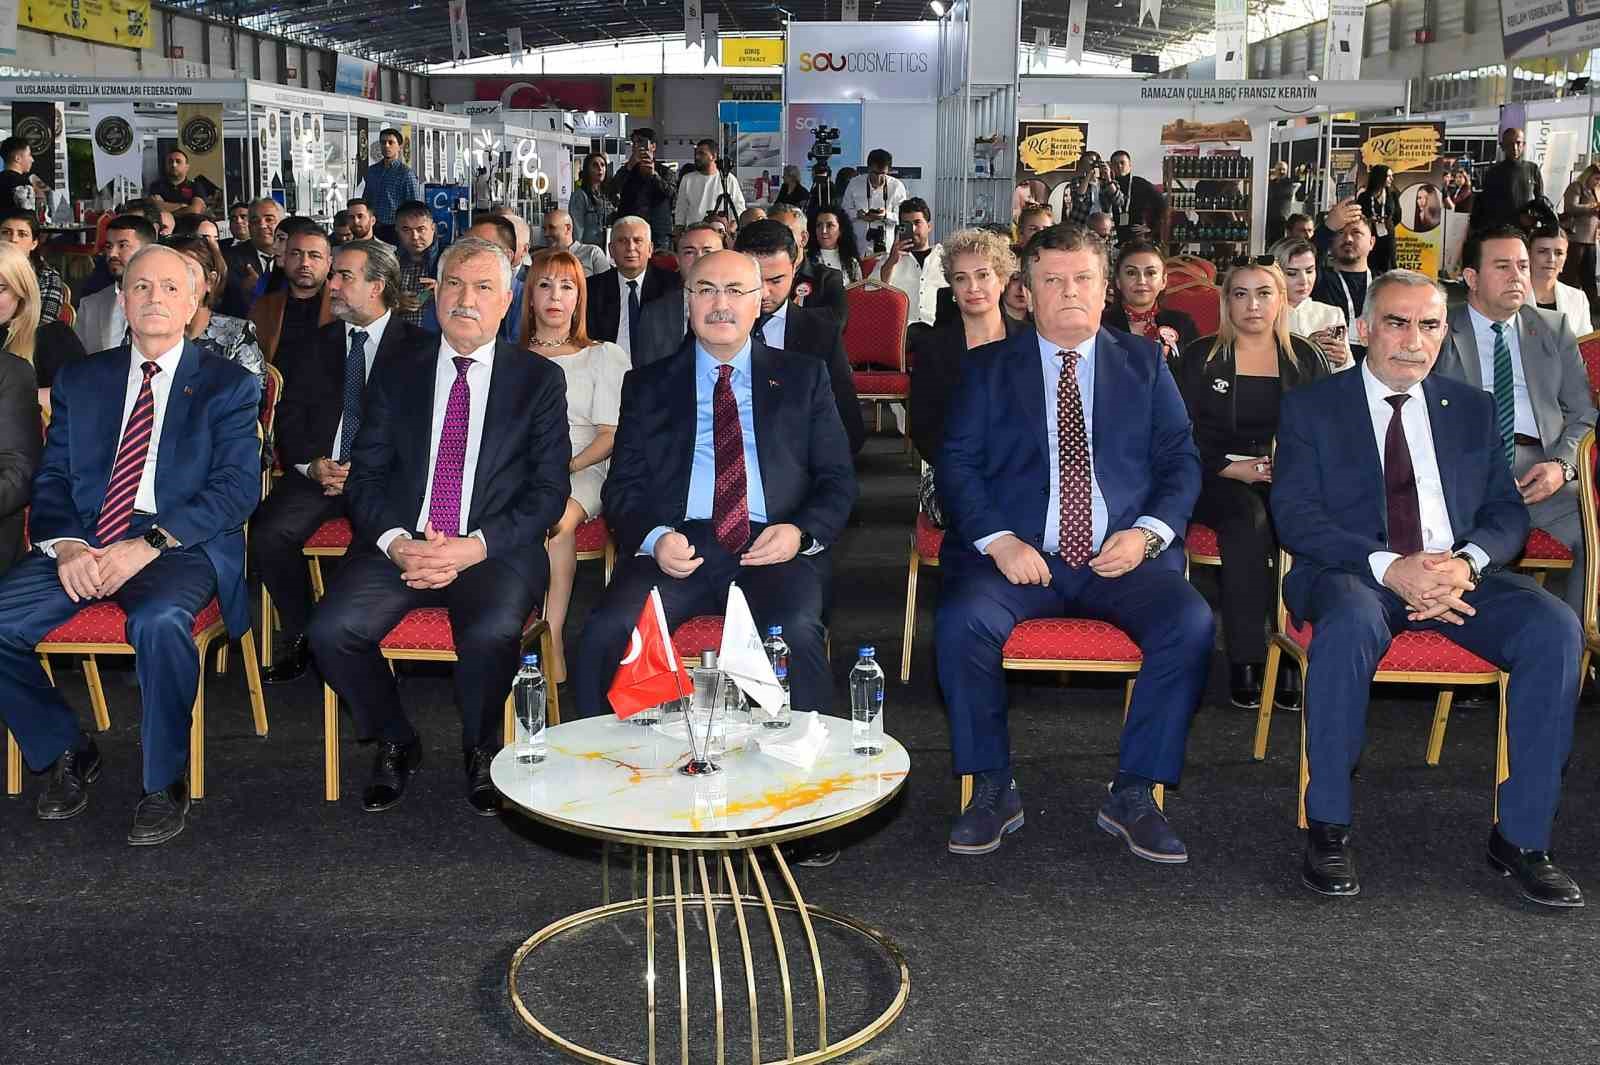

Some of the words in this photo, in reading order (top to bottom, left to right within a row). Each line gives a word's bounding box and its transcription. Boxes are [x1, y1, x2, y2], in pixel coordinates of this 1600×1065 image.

[848, 52, 928, 73] COSMETICS
[15, 84, 67, 95] ULUSLARARASI
[67, 83, 100, 96] GÜZELLİK
[101, 85, 142, 96] UZMANLARI
[143, 85, 192, 96] FEDERASYONU
[1141, 87, 1185, 99] RAMAZAN
[1187, 87, 1217, 100] ÇULHA
[1238, 87, 1276, 99] FRANSIZ
[1278, 84, 1317, 99] KERATİN
